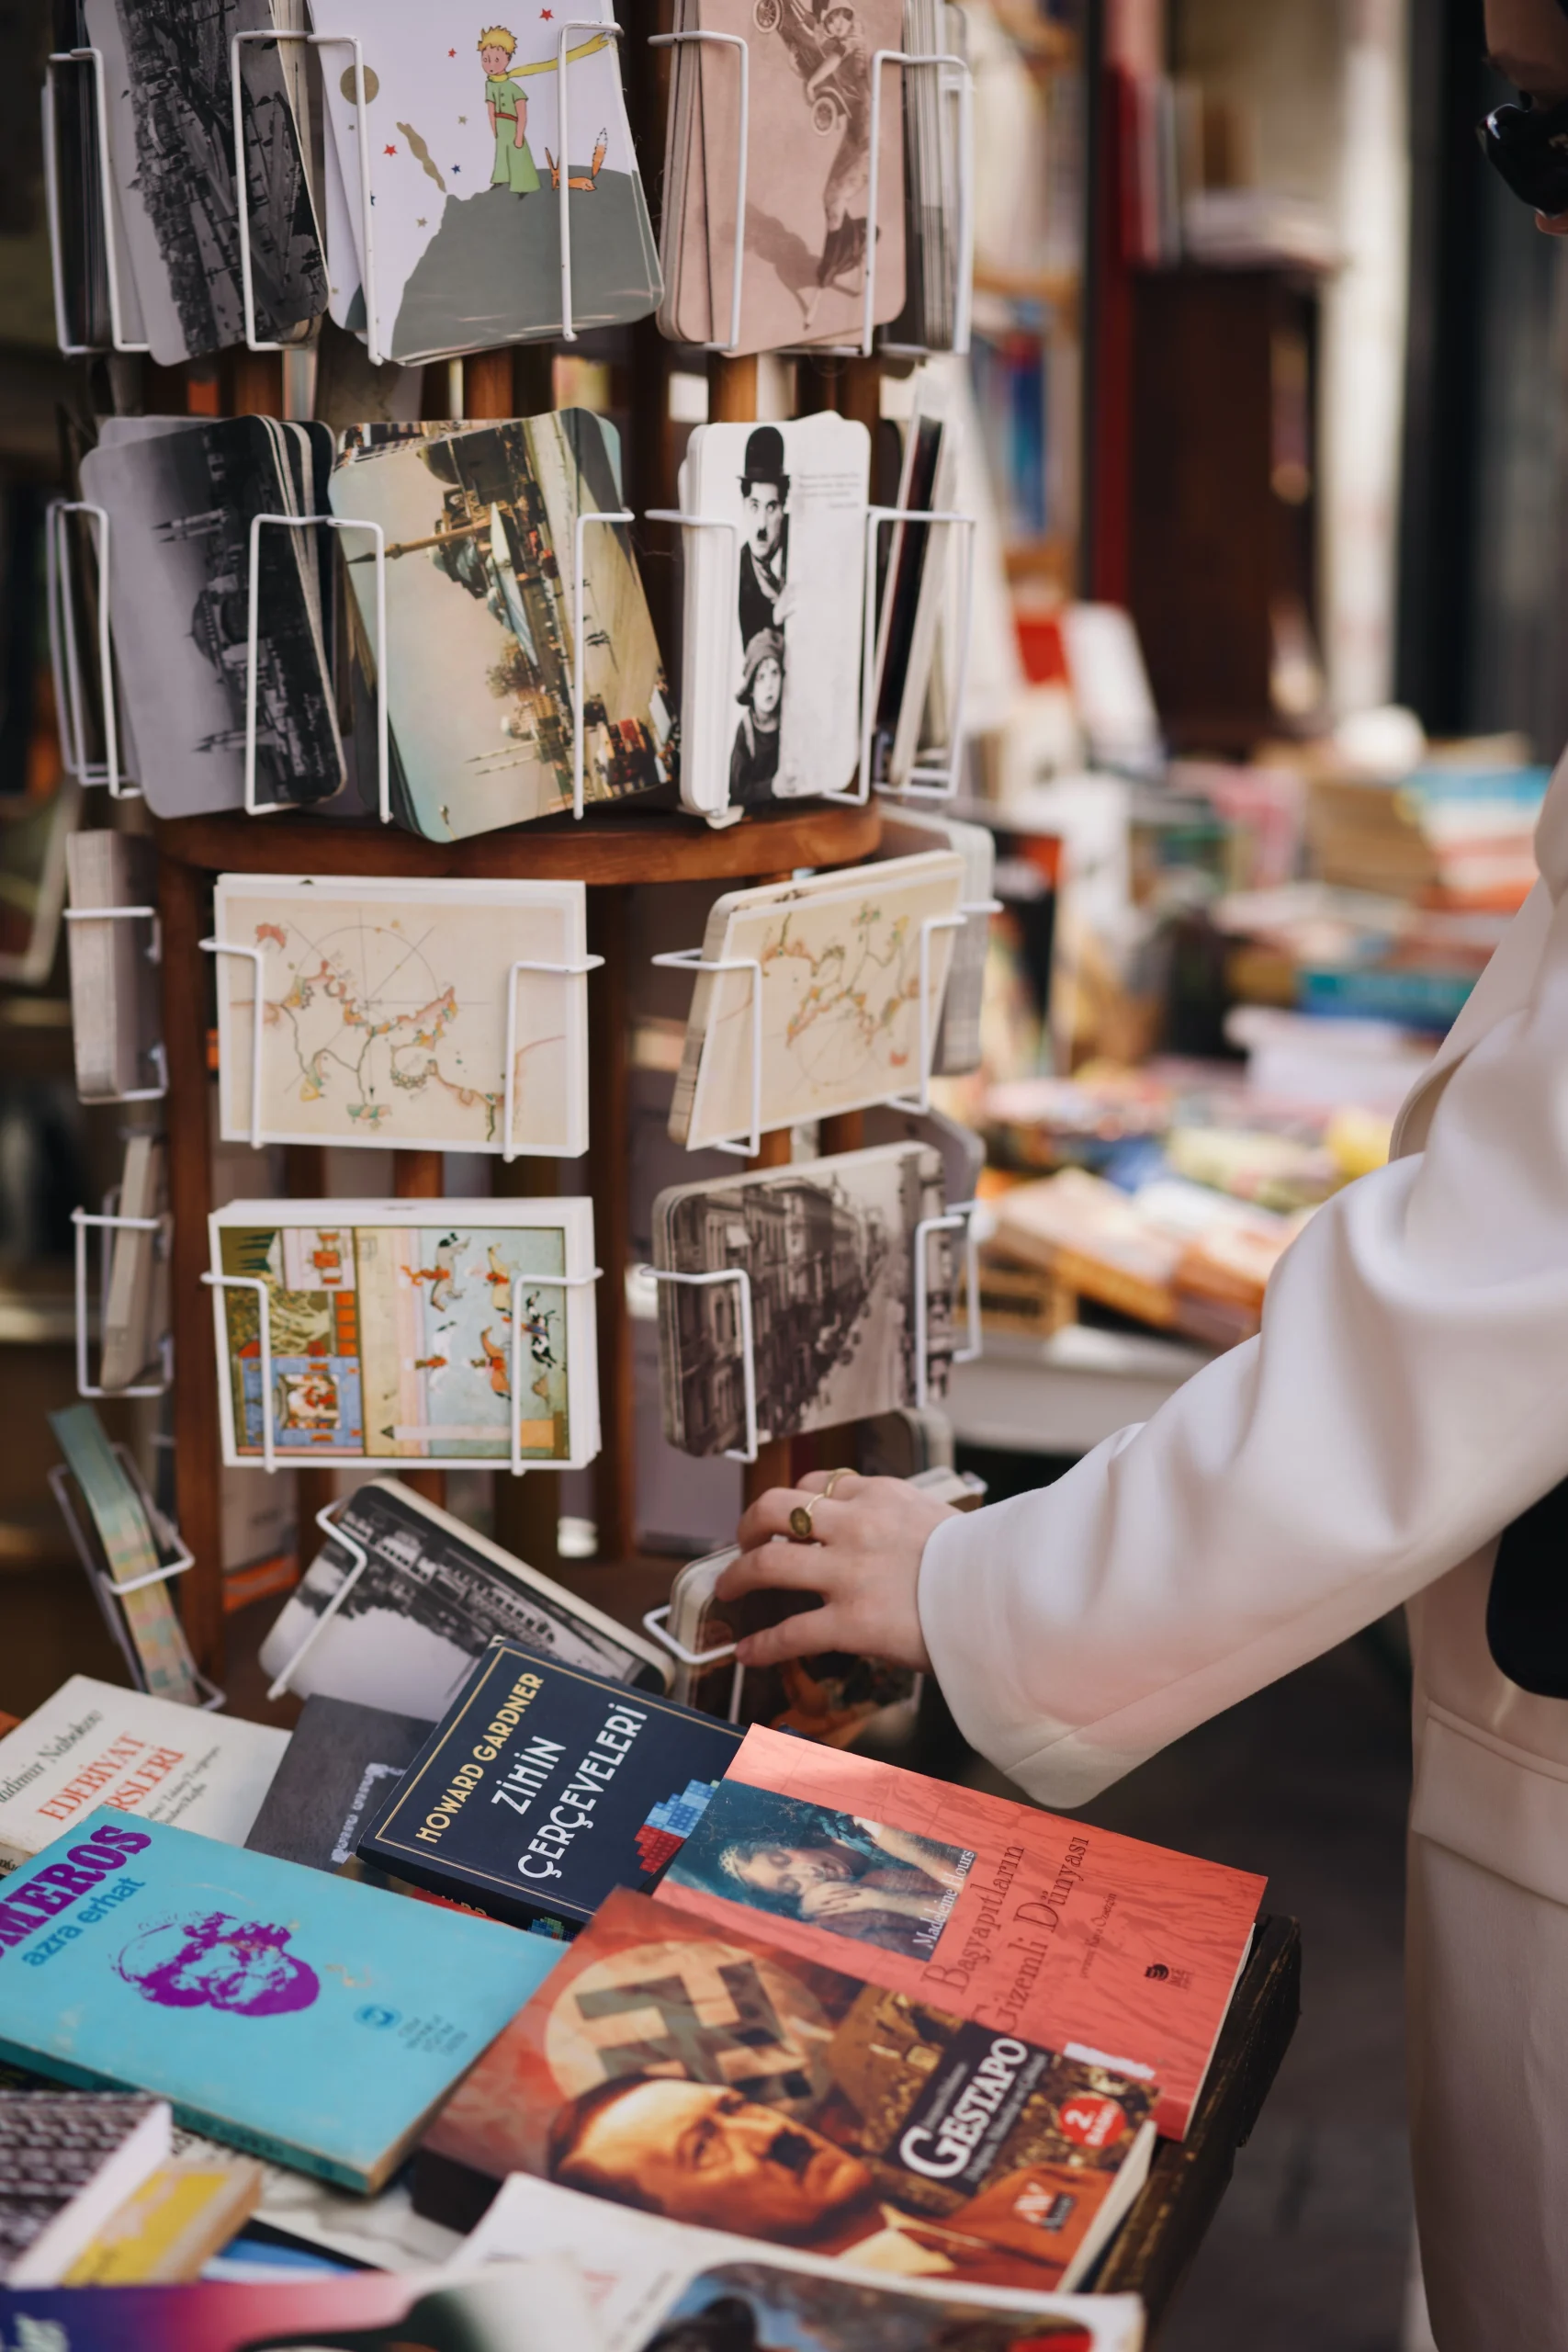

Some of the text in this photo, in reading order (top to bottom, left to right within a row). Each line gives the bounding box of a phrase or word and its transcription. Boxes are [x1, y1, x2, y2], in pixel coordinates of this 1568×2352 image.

[0, 1761, 46, 1804] adimir
[36, 1730, 146, 1821] EDEBİYAT
[102, 1745, 186, 1812] RSLERİ
[415, 1764, 484, 1843] HOWARD
[473, 1673, 544, 1761] GARDNER
[491, 1736, 567, 1815] ZİHİN
[517, 1702, 648, 1879] ÇERÇEVELERİ
[0, 1825, 152, 1959] MEROS
[21, 1877, 146, 1967] azra erhat
[912, 1849, 975, 1951] Madeleine Hours
[919, 1846, 1025, 1996] Başyapıtların
[1013, 1837, 1089, 1934] Dünyası
[899, 2038, 1028, 2178] GESTAPO
